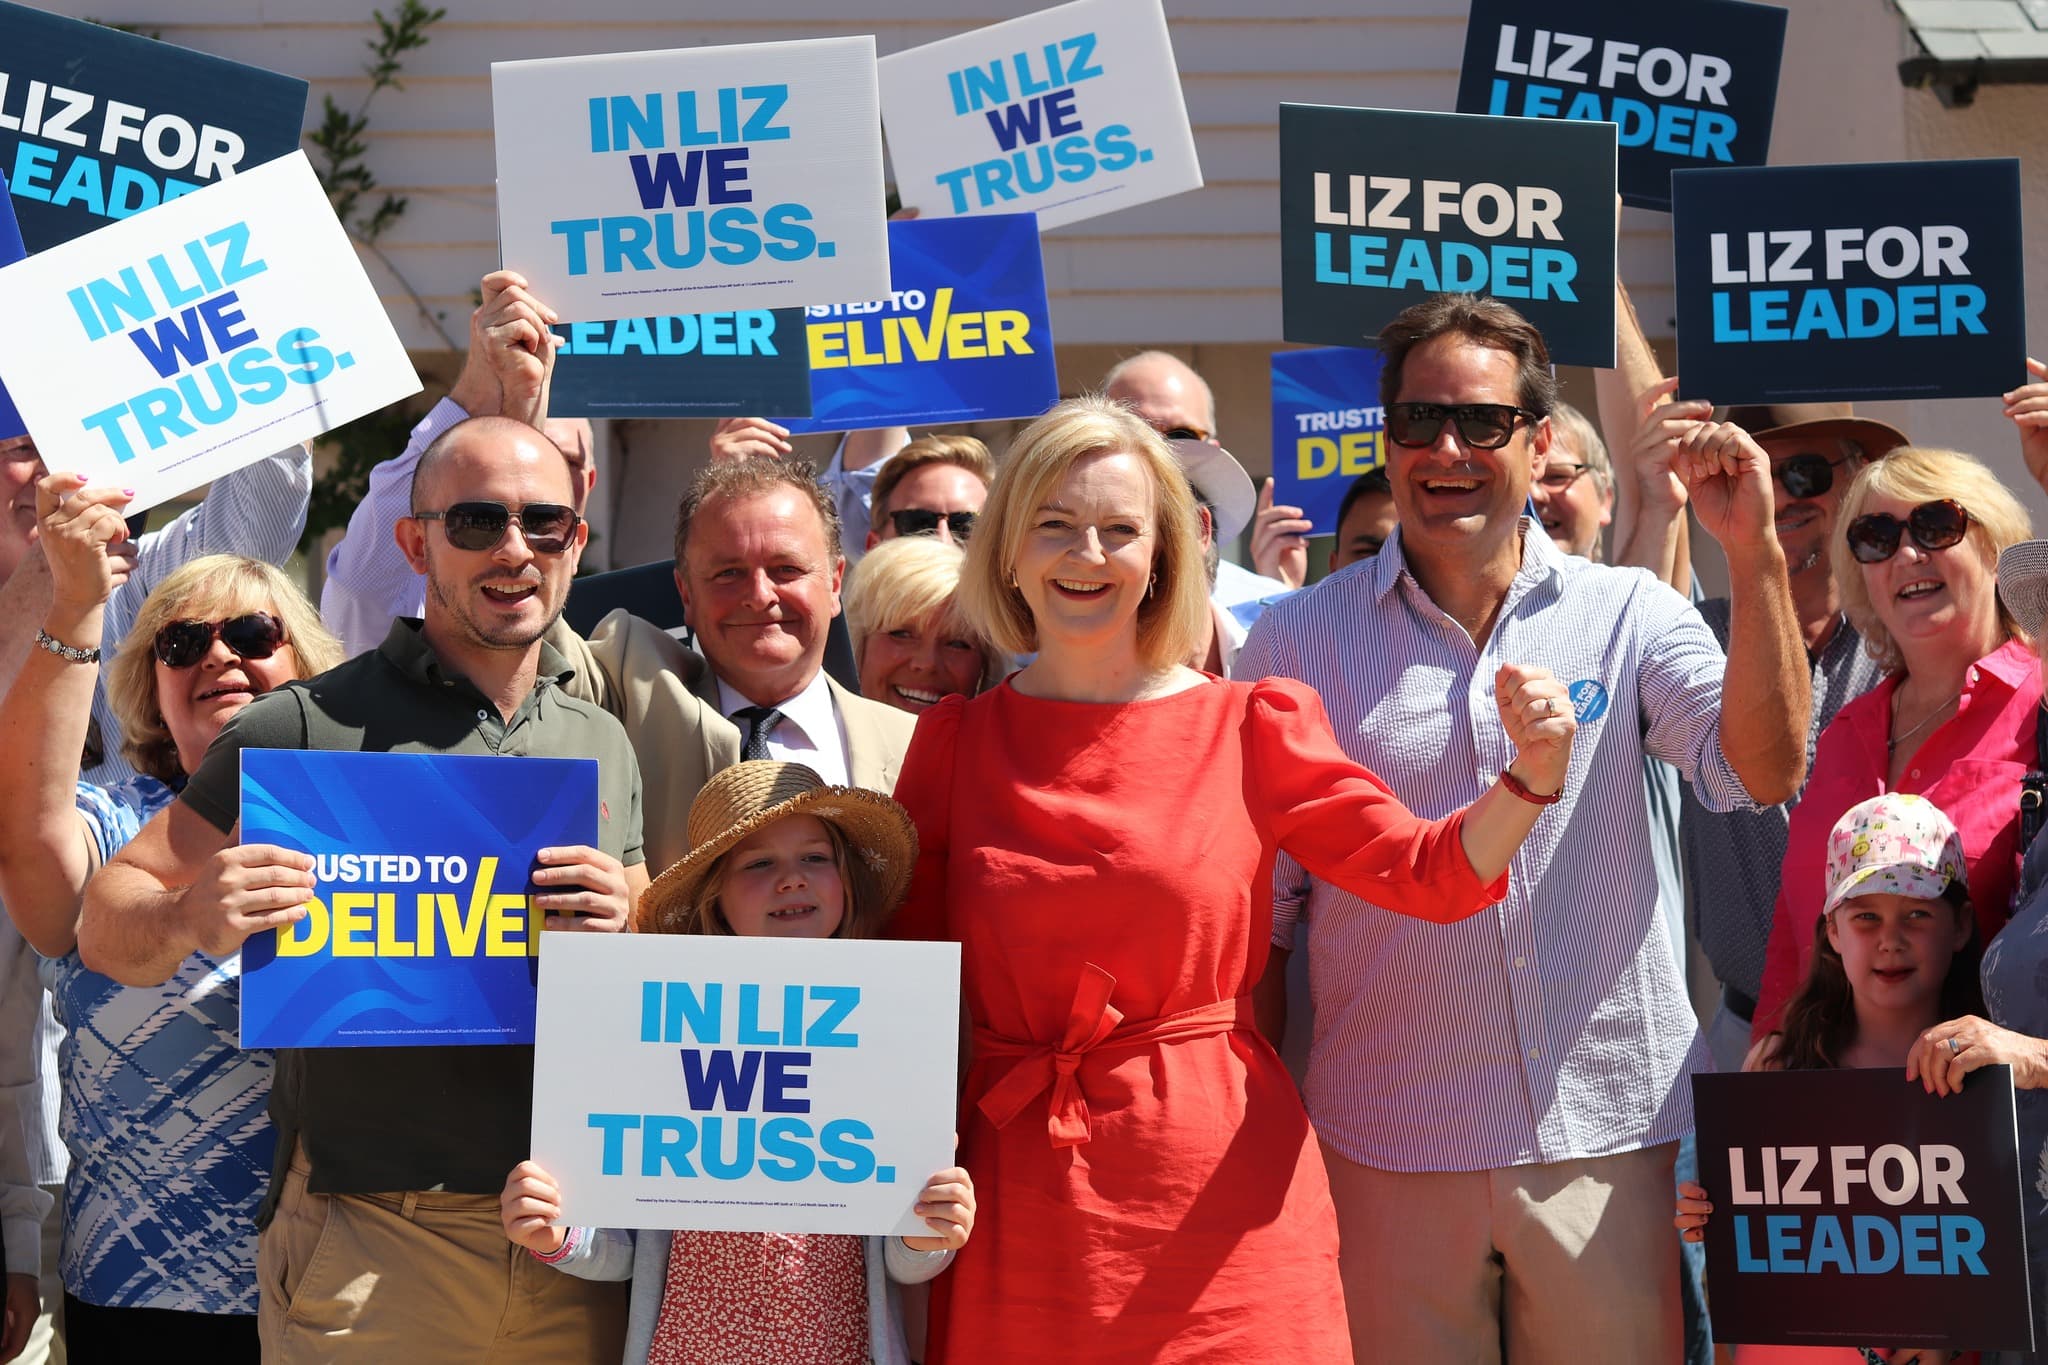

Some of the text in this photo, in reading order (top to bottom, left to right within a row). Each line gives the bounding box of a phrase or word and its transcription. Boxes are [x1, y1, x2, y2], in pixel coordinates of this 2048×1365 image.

[947, 32, 1104, 117] IN LIZ
[1495, 24, 1732, 106] LIZ FOR
[0, 72, 246, 181] LIZ FOR
[589, 83, 791, 154] IN LIZ
[986, 88, 1083, 152] WE
[1488, 78, 1738, 162] LEADER
[629, 147, 753, 210] WE
[935, 123, 1155, 215] TRUSS.
[551, 202, 837, 276] TRUSS.
[1314, 172, 1564, 241] LIZ FOR
[67, 221, 268, 341] IN LIZ
[1314, 231, 1579, 303] LEADER
[1710, 225, 1971, 284] LIZ FOR
[128, 290, 259, 379] WE
[806, 287, 1035, 370] ELIVER
[889, 289, 926, 312] TO
[1712, 284, 1989, 343] LEADER
[82, 327, 355, 464] TRUSS.
[1295, 406, 1386, 433] TRUST
[1575, 684, 1601, 719] LEADER
[1577, 681, 1594, 700] FOR
[309, 853, 468, 884] USTED TO
[640, 980, 861, 1049] IN LIZ
[680, 1048, 812, 1114] WE
[588, 1113, 897, 1184] TRUSS.
[1728, 1143, 1969, 1206] LIZ FOR
[1734, 1215, 1990, 1276] LEADER
